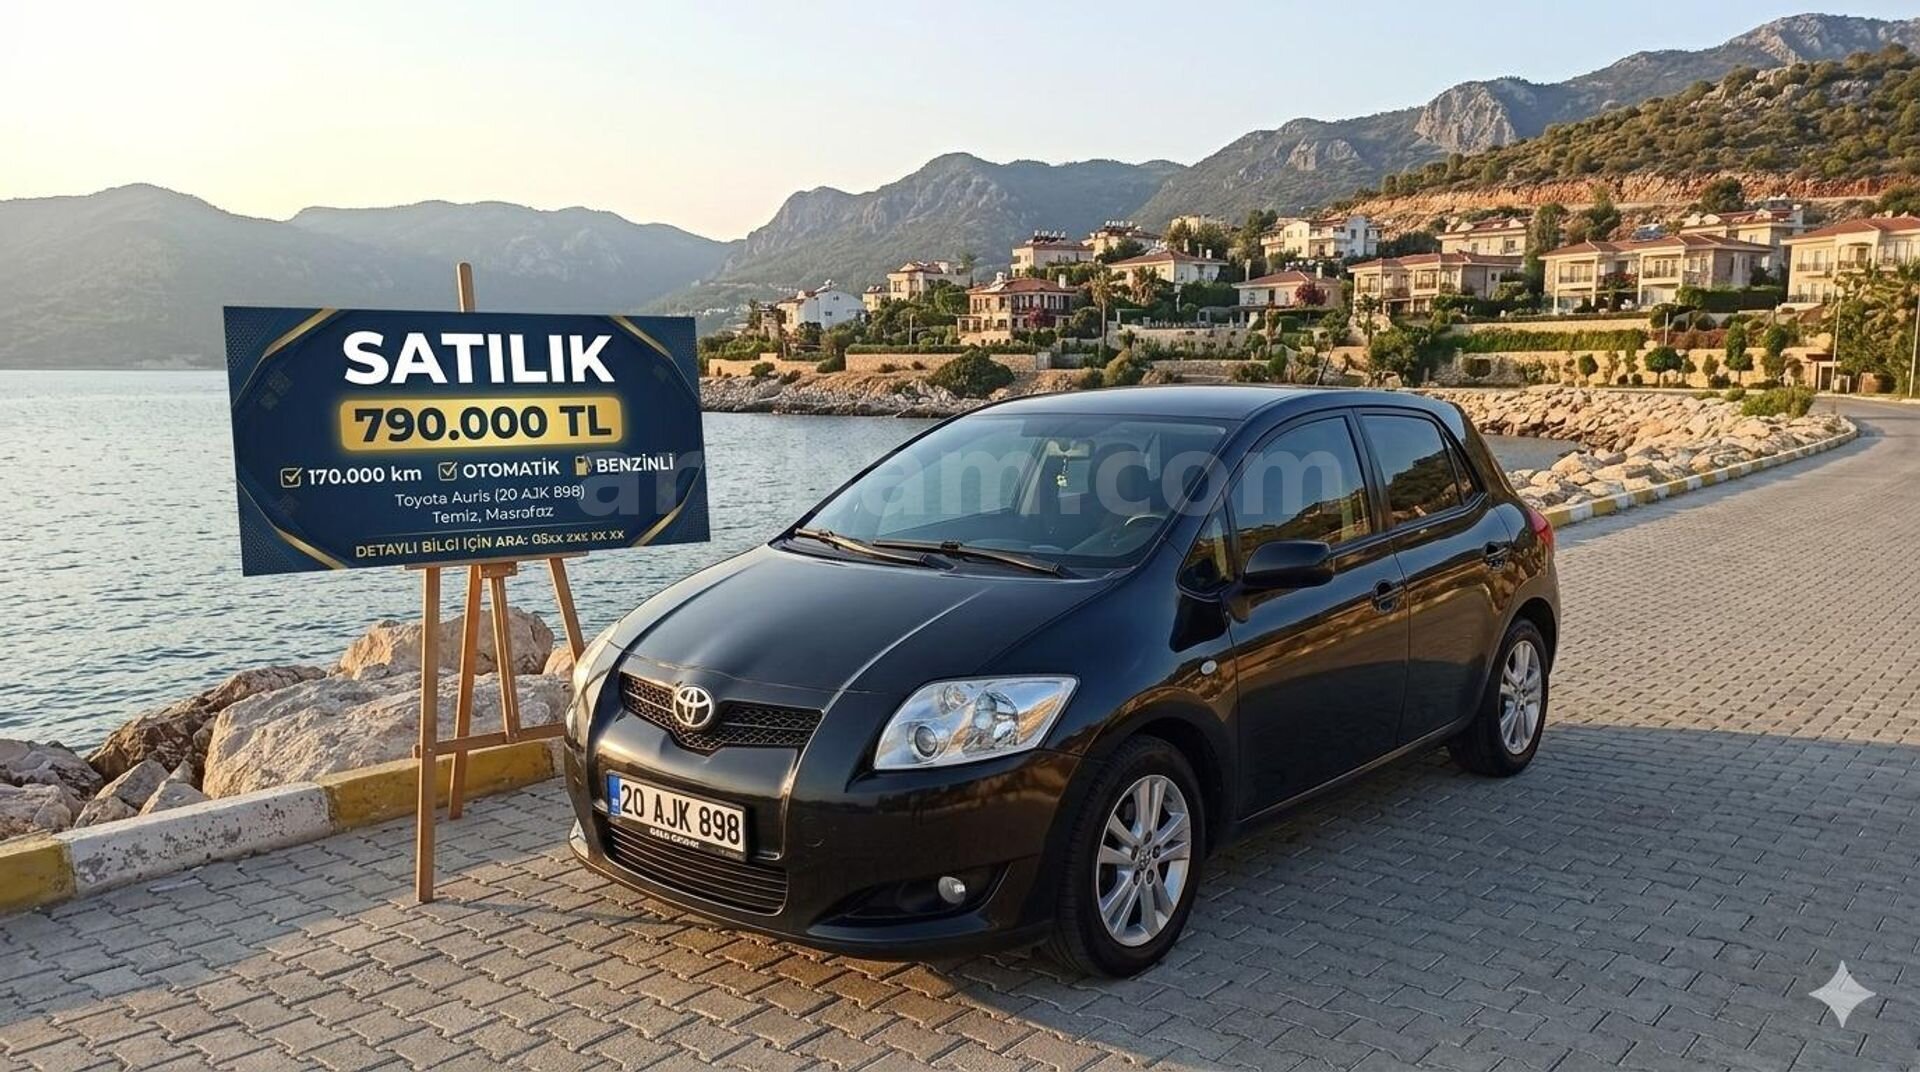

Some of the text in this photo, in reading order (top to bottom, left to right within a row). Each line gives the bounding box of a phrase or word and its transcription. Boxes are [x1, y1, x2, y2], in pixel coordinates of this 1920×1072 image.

[343, 331, 616, 385] SATILIK
[354, 405, 612, 442] 790.000 TL
[308, 453, 674, 485] 170.000 km OTOMATİK BENZİNLİ
[395, 485, 585, 509] Toyota Auris (20 AJK 898)
[432, 509, 482, 524] Temiz,
[621, 784, 645, 818] 20
[653, 794, 692, 833] AJK
[699, 806, 740, 845] 898
